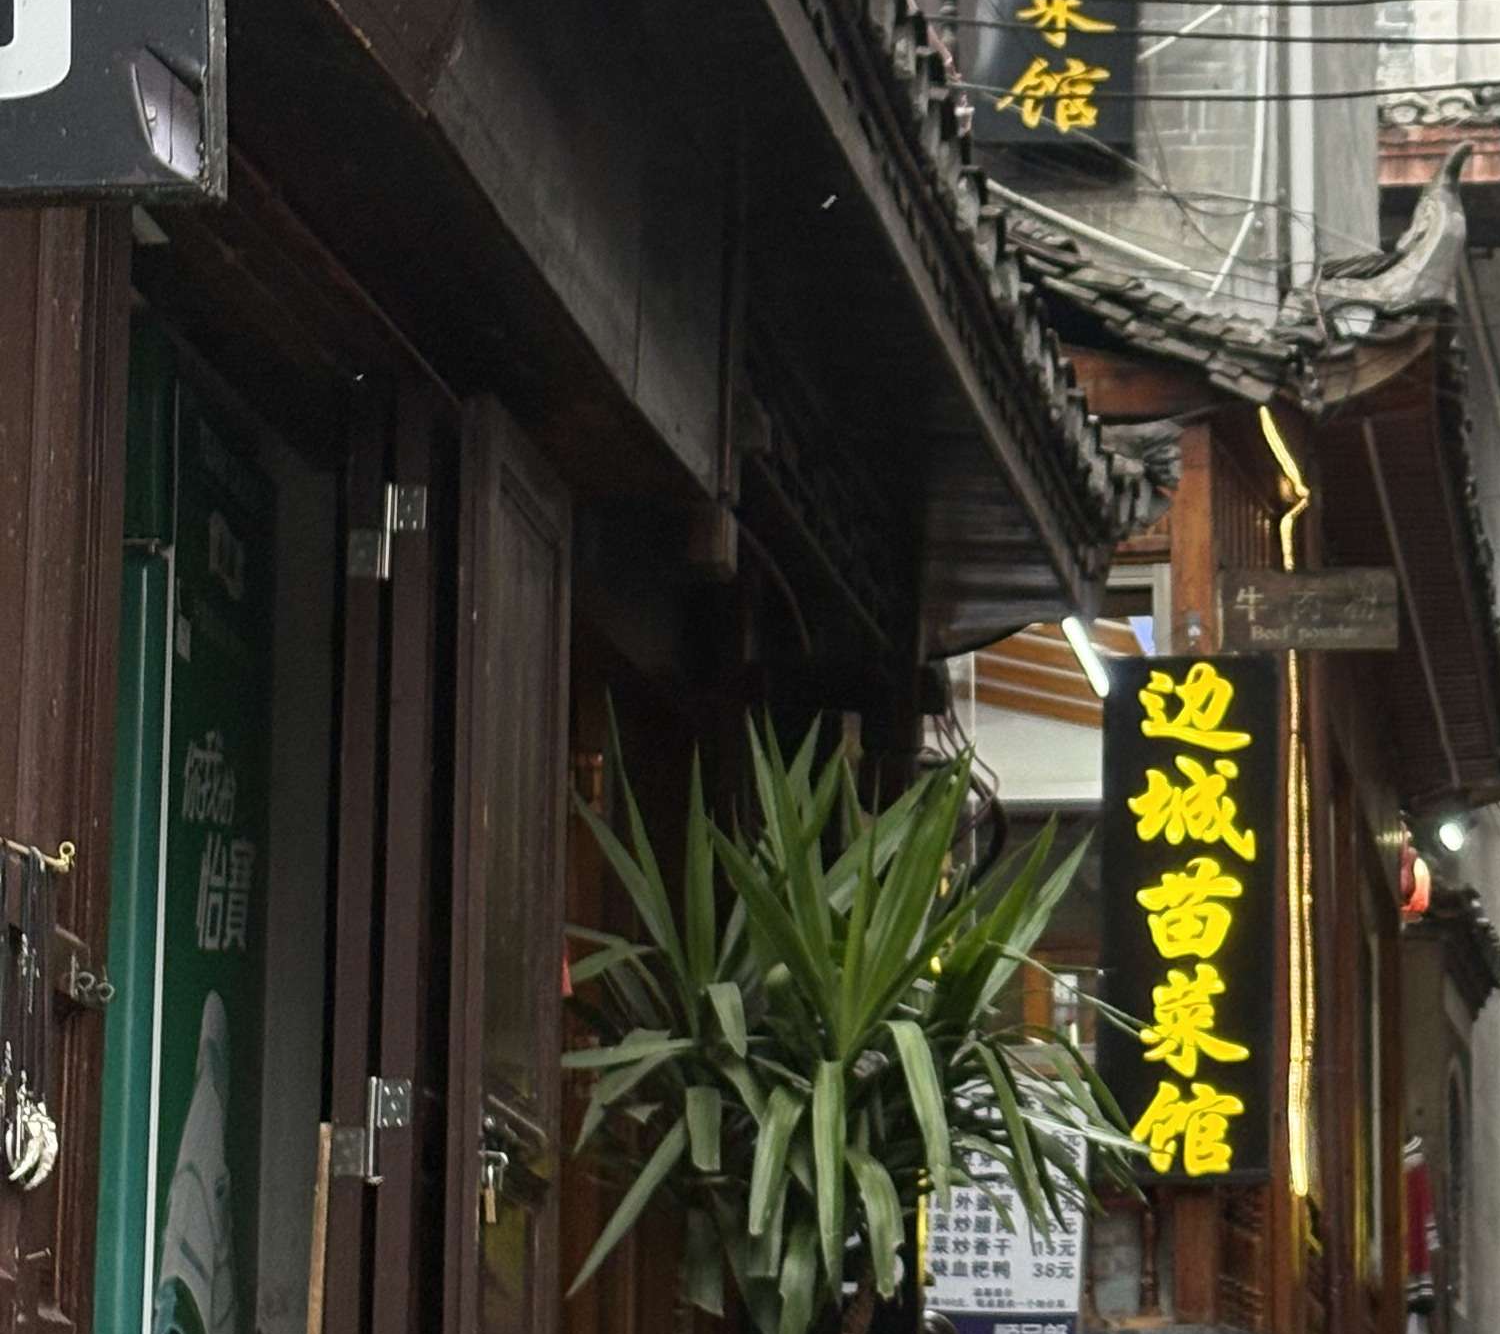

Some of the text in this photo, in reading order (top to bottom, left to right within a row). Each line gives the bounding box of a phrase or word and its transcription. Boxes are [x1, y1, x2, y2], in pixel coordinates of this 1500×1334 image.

[1127, 661, 1257, 1177] 边城苗菜馆
[934, 1192, 1014, 1214] 外婆菜
[932, 1236, 1012, 1256] 菜炒香干
